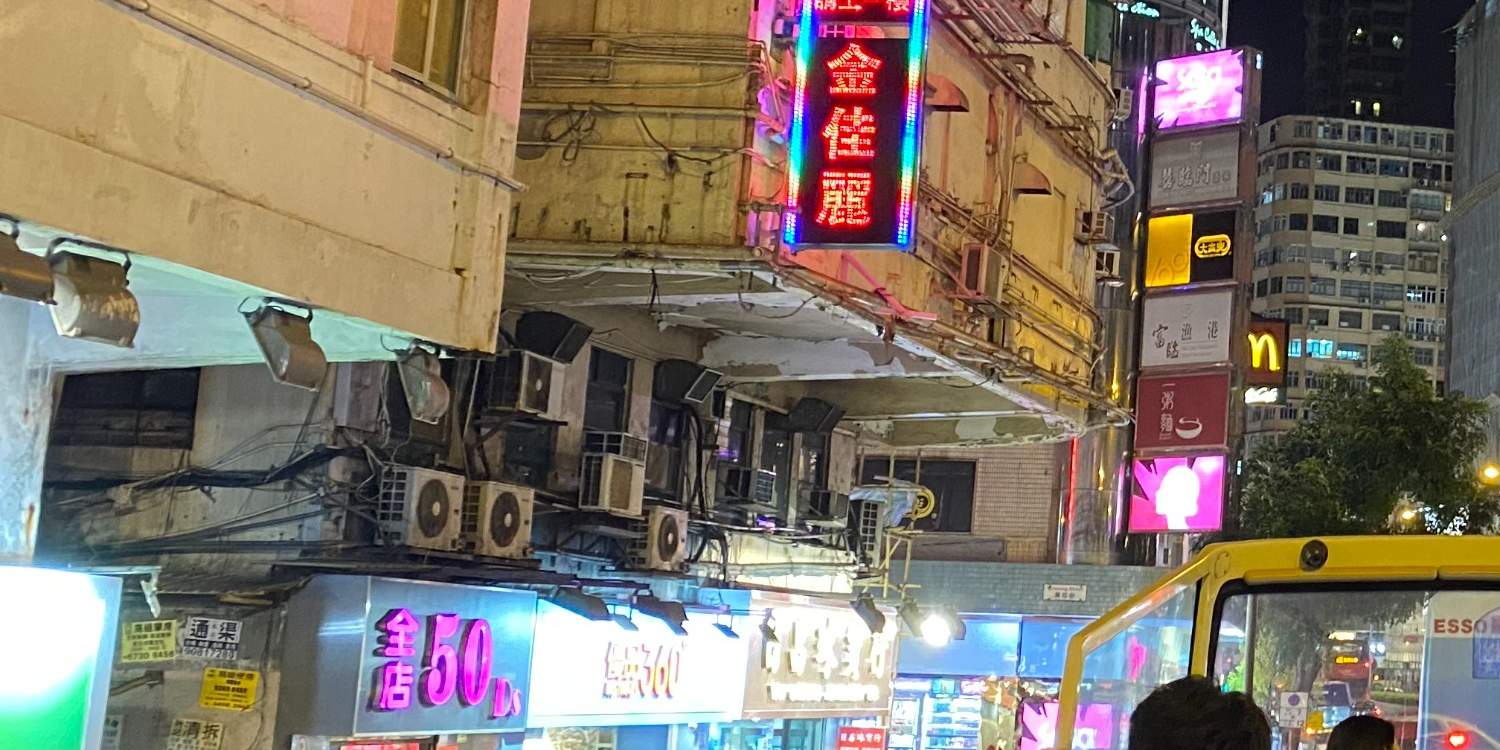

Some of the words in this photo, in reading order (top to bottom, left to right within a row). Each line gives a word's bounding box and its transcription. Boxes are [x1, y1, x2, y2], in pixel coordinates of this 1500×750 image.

[816, 43, 882, 226] 金佳麗
[378, 608, 419, 710] 全店
